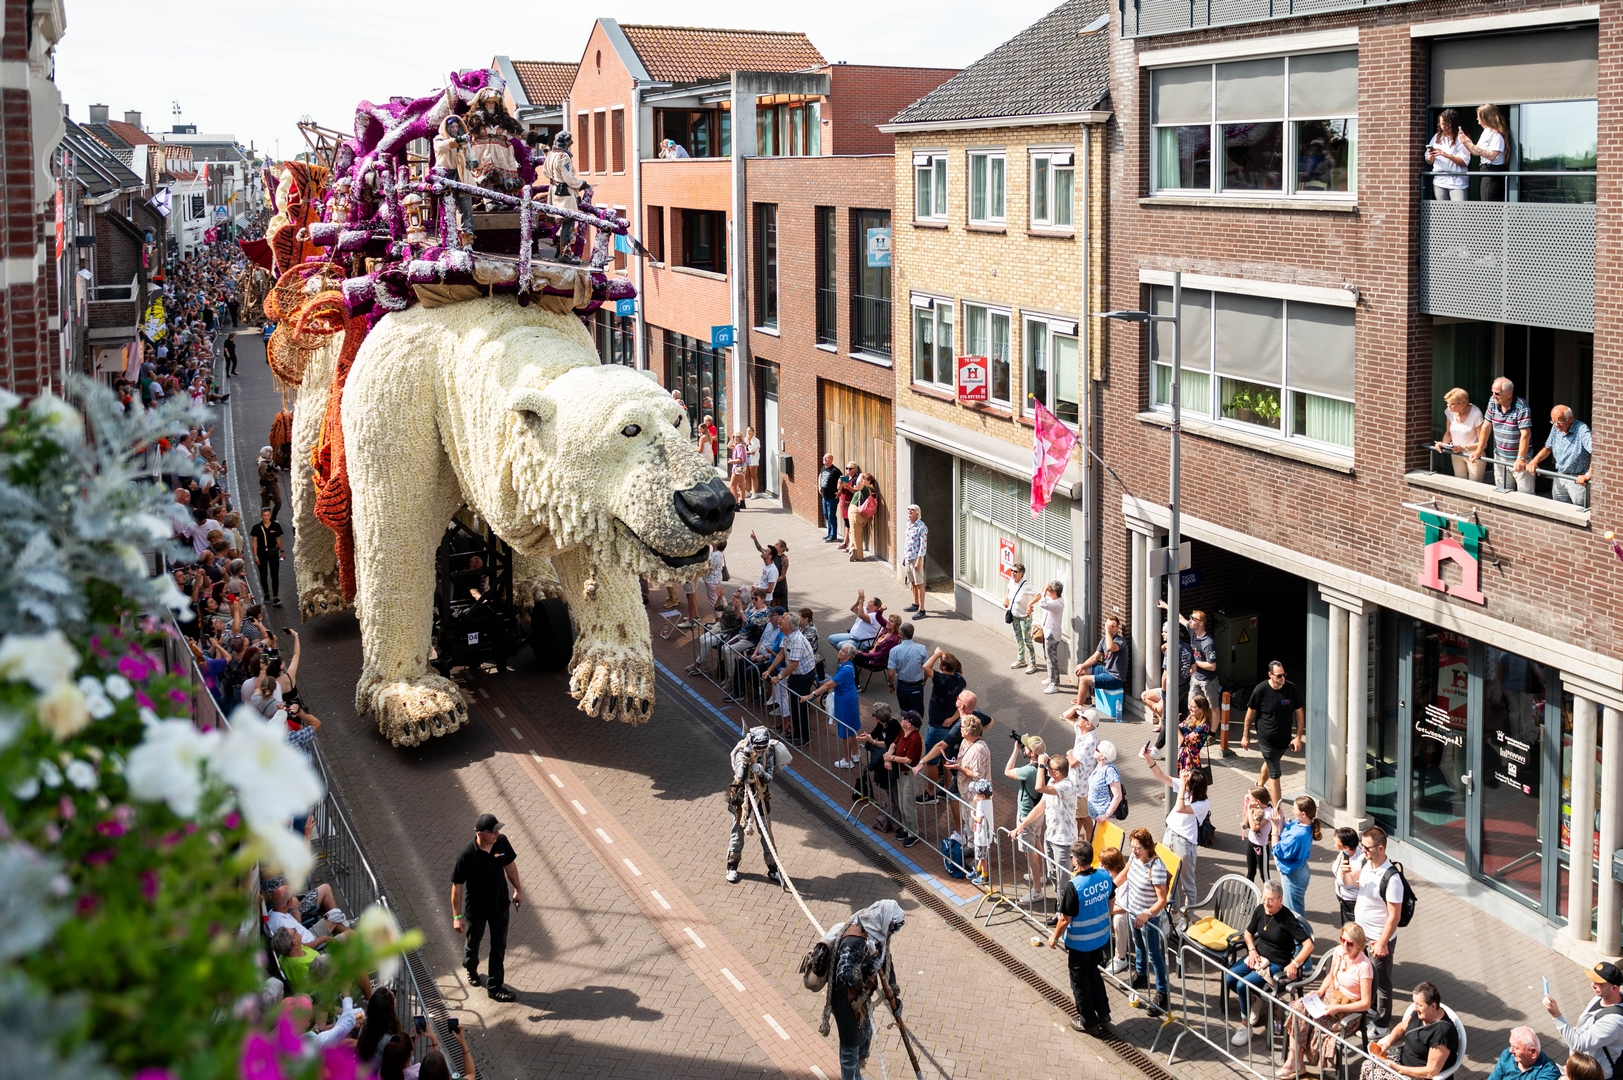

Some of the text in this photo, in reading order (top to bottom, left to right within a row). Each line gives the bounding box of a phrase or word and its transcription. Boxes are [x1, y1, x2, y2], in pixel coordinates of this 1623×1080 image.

[1444, 631, 1455, 640] TE
[1083, 880, 1109, 897] corso
[1084, 890, 1109, 906] zundert
